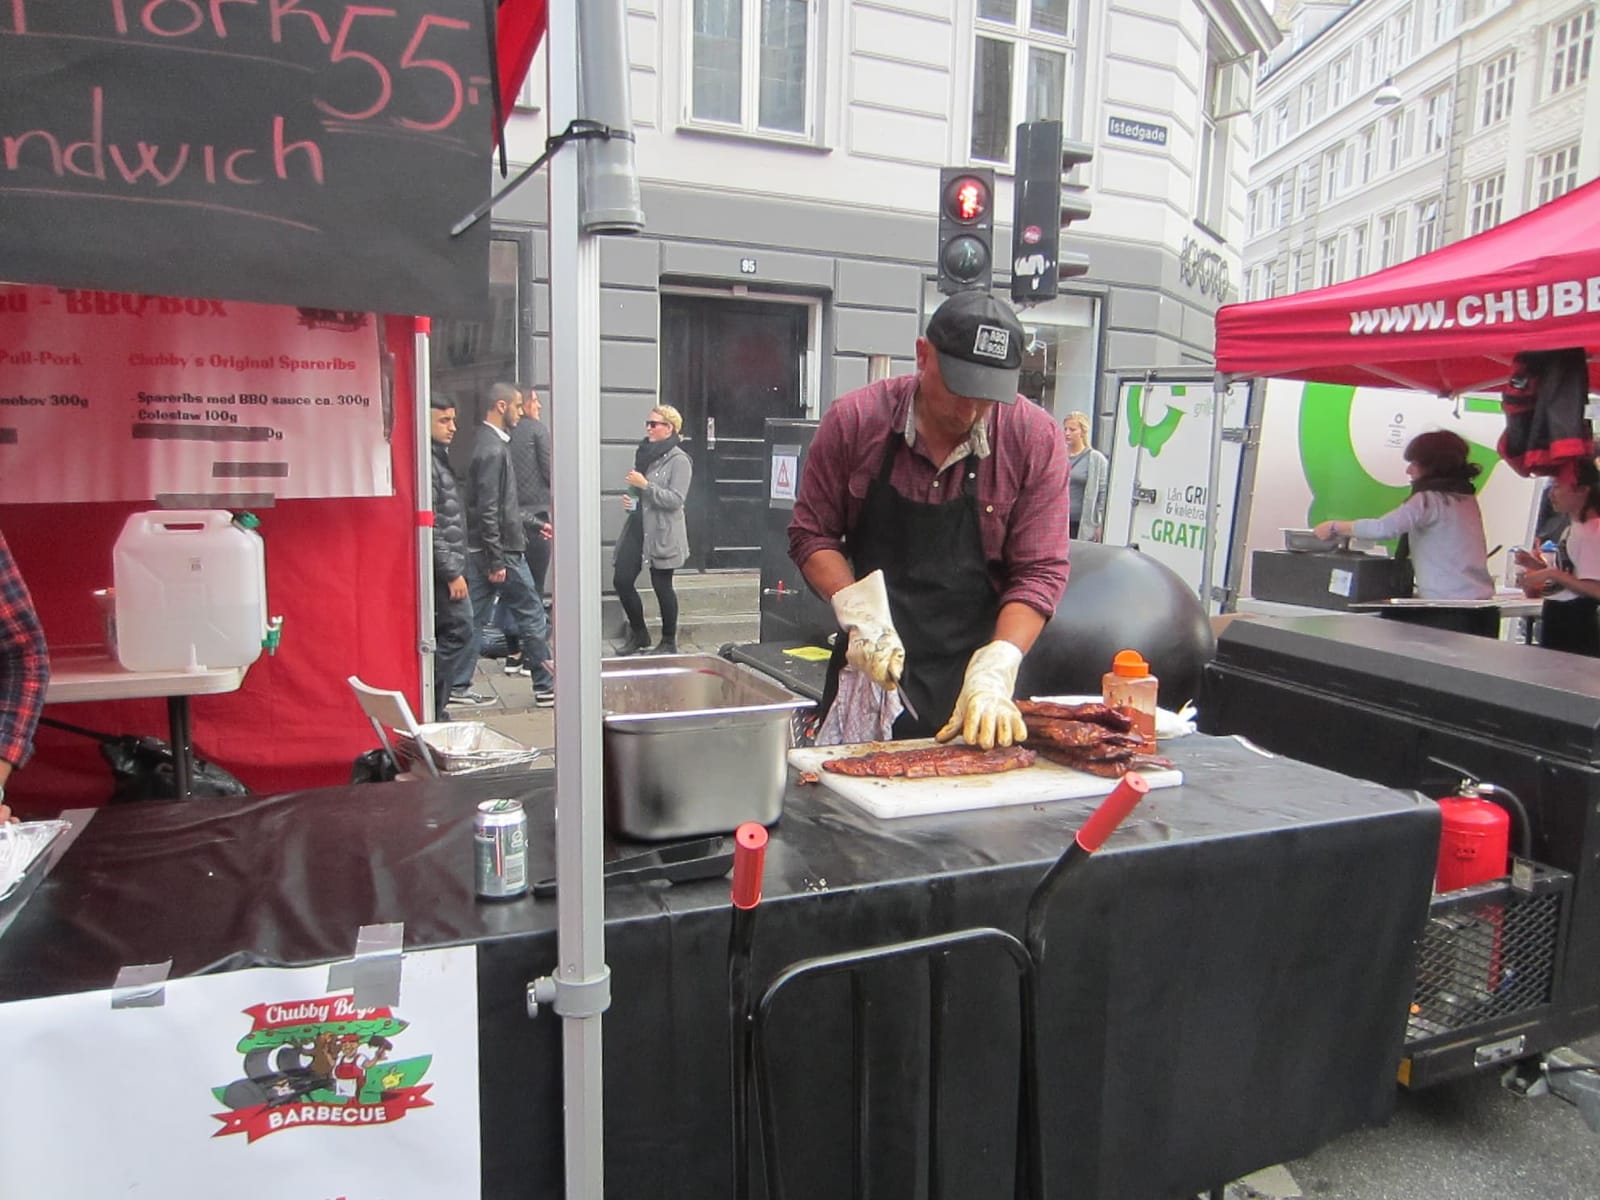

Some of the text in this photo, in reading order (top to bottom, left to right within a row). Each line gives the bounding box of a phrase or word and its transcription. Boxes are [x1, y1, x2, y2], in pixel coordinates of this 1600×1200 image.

[2, 86, 325, 187] ndwich
[1110, 119, 1165, 142] Istedgade
[210, 355, 274, 372] Original
[279, 356, 356, 372] Spareribs
[138, 392, 201, 406] Spareribs
[207, 394, 236, 406] med
[239, 395, 268, 406] BBQ
[272, 396, 311, 406] sauce
[337, 395, 370, 408] 300g
[138, 410, 238, 424] Coleslaw 100g
[1185, 485, 1208, 505] GRI
[1174, 504, 1208, 521] køletra
[1151, 518, 1208, 551] GRATI
[265, 1003, 329, 1023] Chubby
[268, 1106, 387, 1129] BARBECUE
